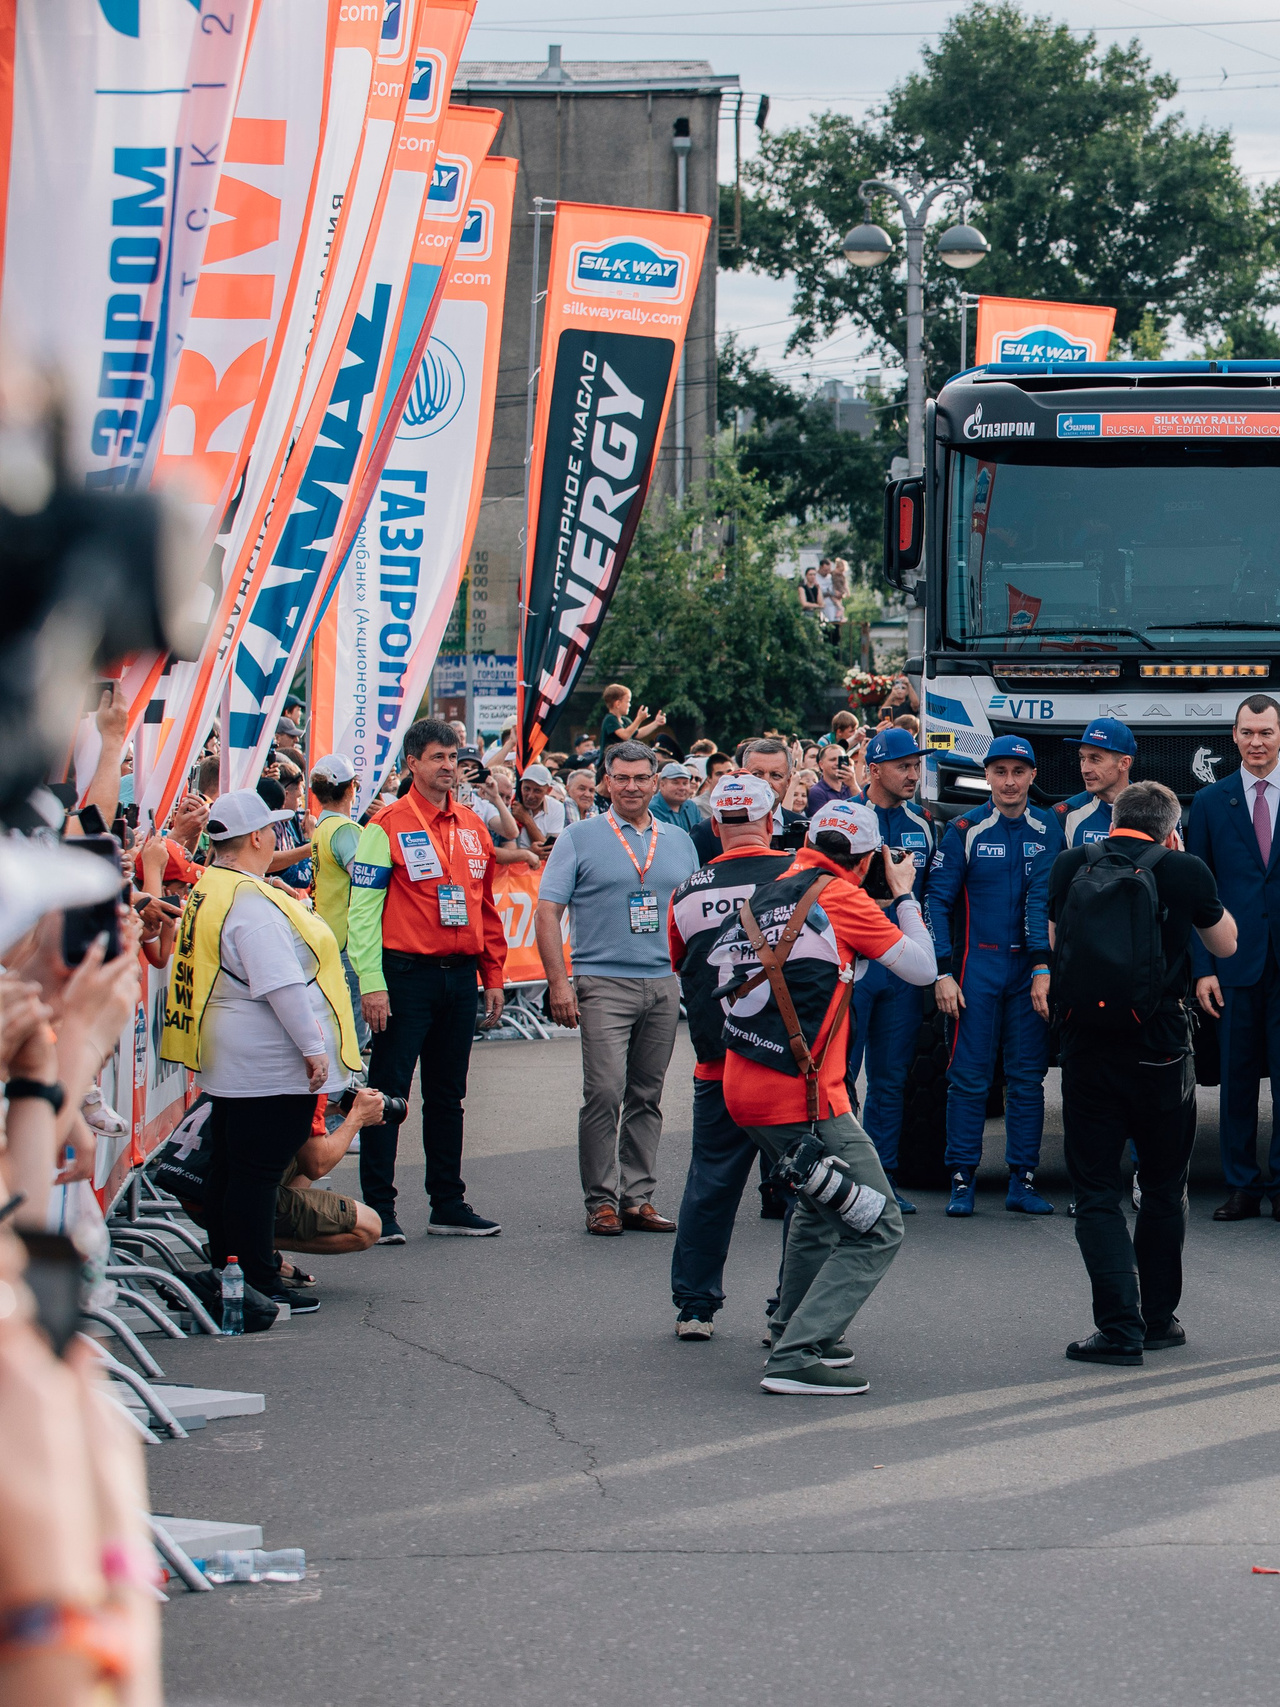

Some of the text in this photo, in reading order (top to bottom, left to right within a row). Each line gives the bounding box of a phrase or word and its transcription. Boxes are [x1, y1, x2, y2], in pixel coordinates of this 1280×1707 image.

[580, 255, 677, 277] SILK WAY
[602, 271, 653, 282] RALLY
[562, 302, 682, 326] silkwayrally.com
[1002, 343, 1086, 361] SILK WAY
[1154, 415, 1248, 424] SILK WAY RALLY
[982, 422, 1035, 438] ГАЗПРОМ
[1106, 425, 1146, 435] RUSSIA
[1157, 425, 1174, 434] 15th
[1176, 425, 1220, 434] EDITION
[1008, 700, 1054, 719] VTB
[986, 846, 1004, 856] VTB
[691, 868, 715, 880] SILK
[691, 875, 715, 886] WAY
[702, 898, 749, 917] POD
[724, 1020, 784, 1054] wayrally.com
[168, 1102, 213, 1161] 4
